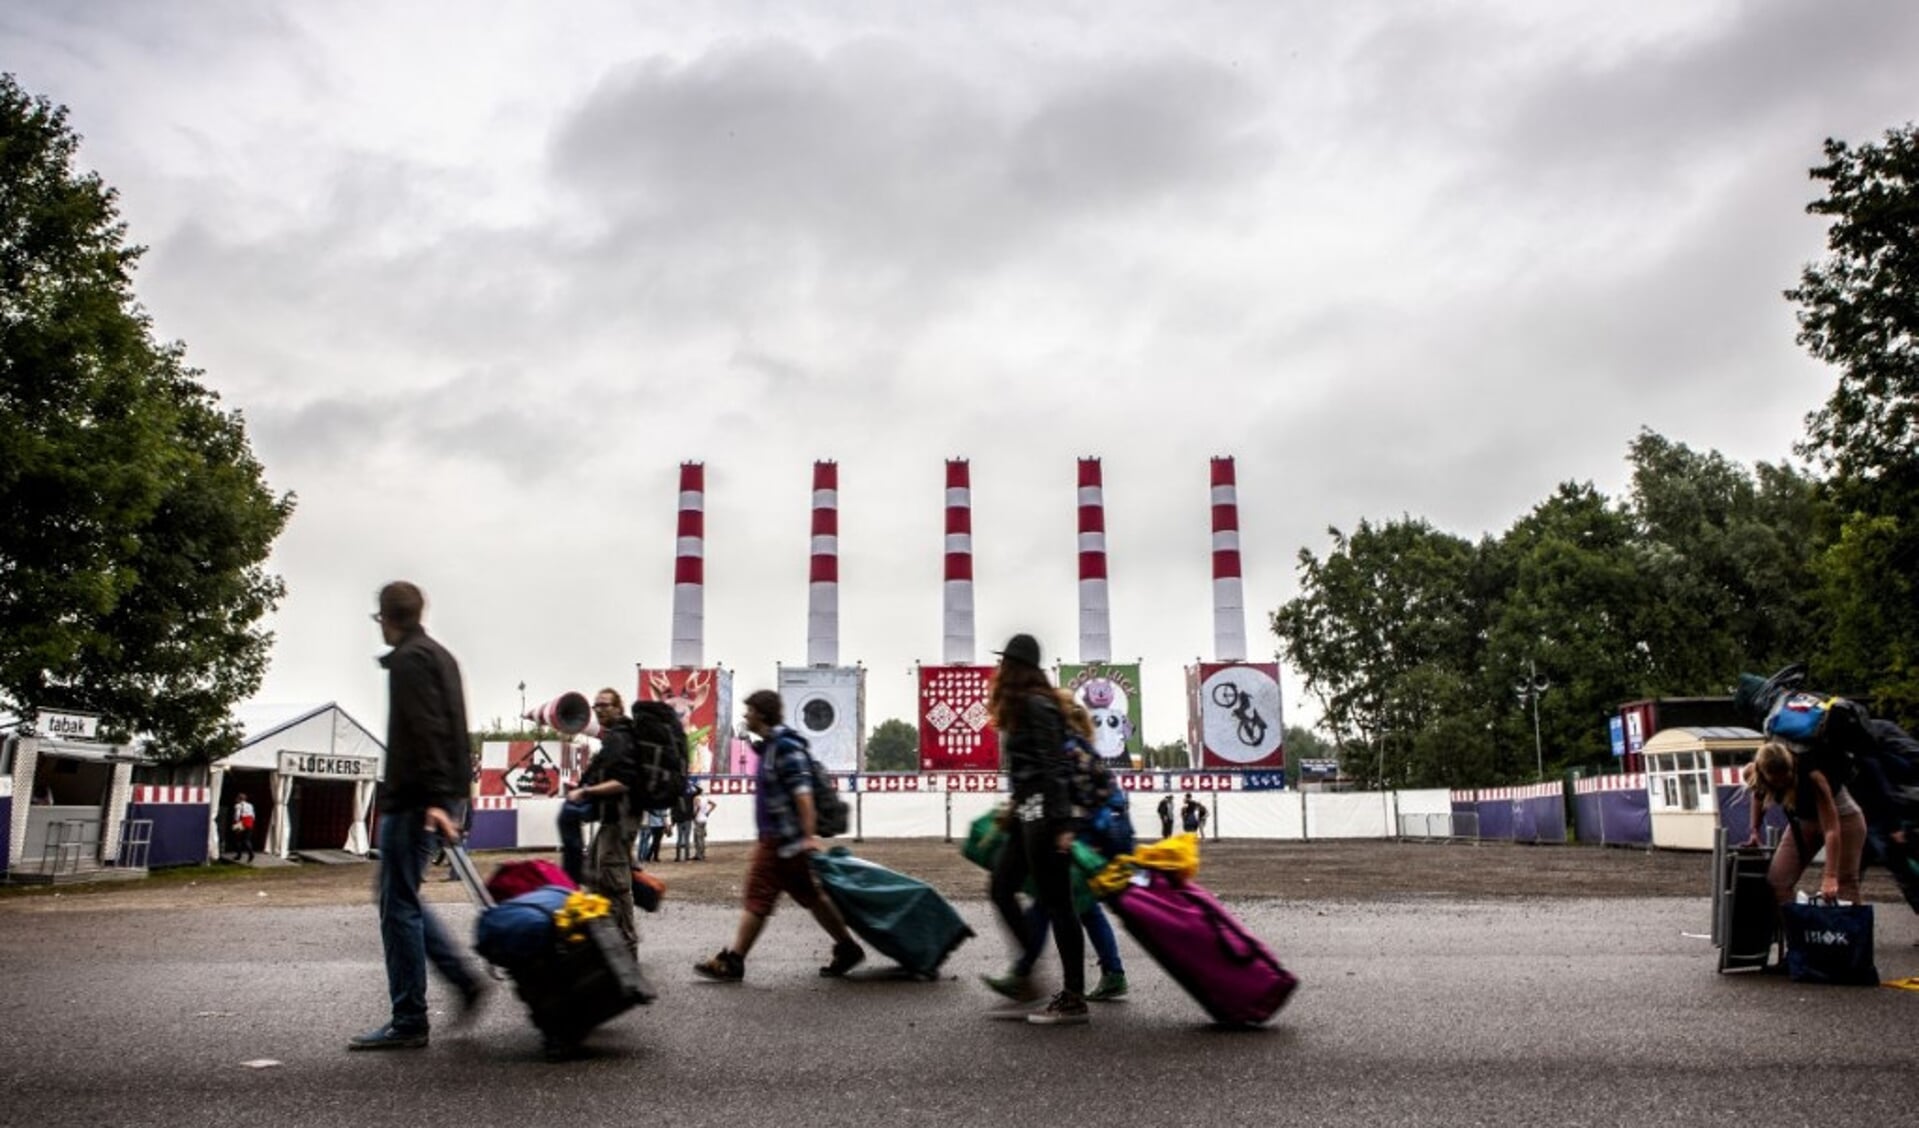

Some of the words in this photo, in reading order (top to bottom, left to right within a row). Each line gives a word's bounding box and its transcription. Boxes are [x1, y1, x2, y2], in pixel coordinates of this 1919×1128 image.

[1105, 667, 1137, 696] LUCK
[49, 716, 84, 733] tabak
[298, 756, 361, 775] LOCKERS
